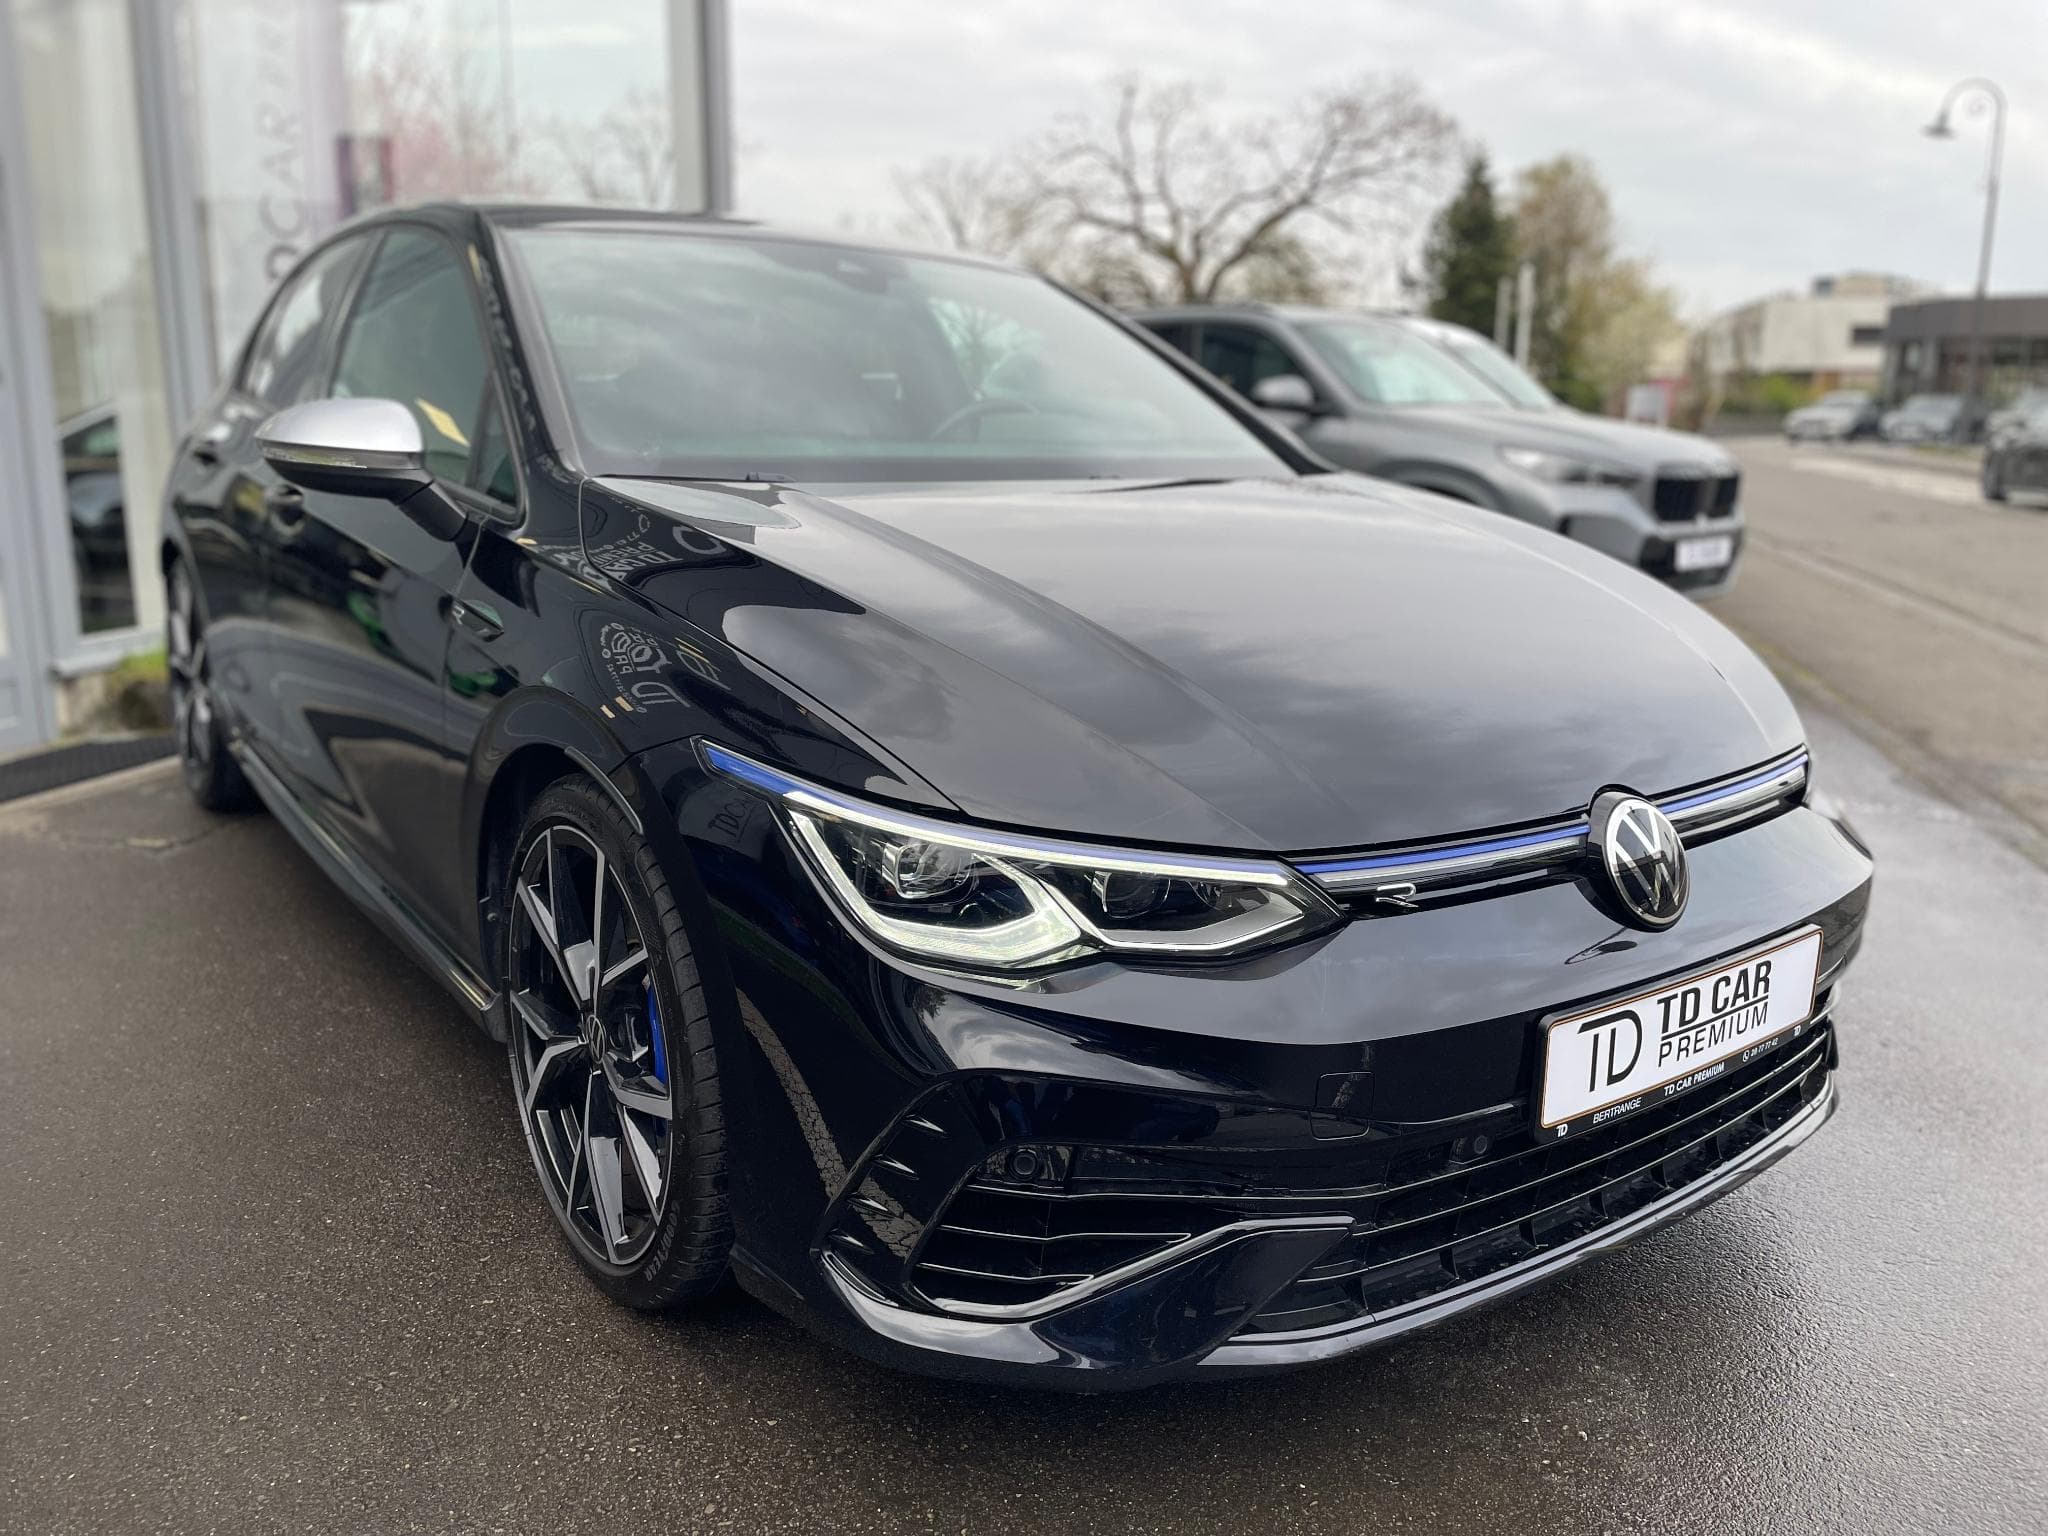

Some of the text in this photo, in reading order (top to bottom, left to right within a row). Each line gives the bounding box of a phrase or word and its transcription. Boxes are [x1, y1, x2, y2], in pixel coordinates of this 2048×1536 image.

[1375, 882, 1419, 909] R
[1656, 959, 1772, 1034] TD CAR
[1577, 1009, 1643, 1092] TD
[1658, 1002, 1769, 1067] PREMIUM
[1664, 1061, 1725, 1096] TD CAR PREMIUM
[1592, 1097, 1642, 1124] BERTRANGE
